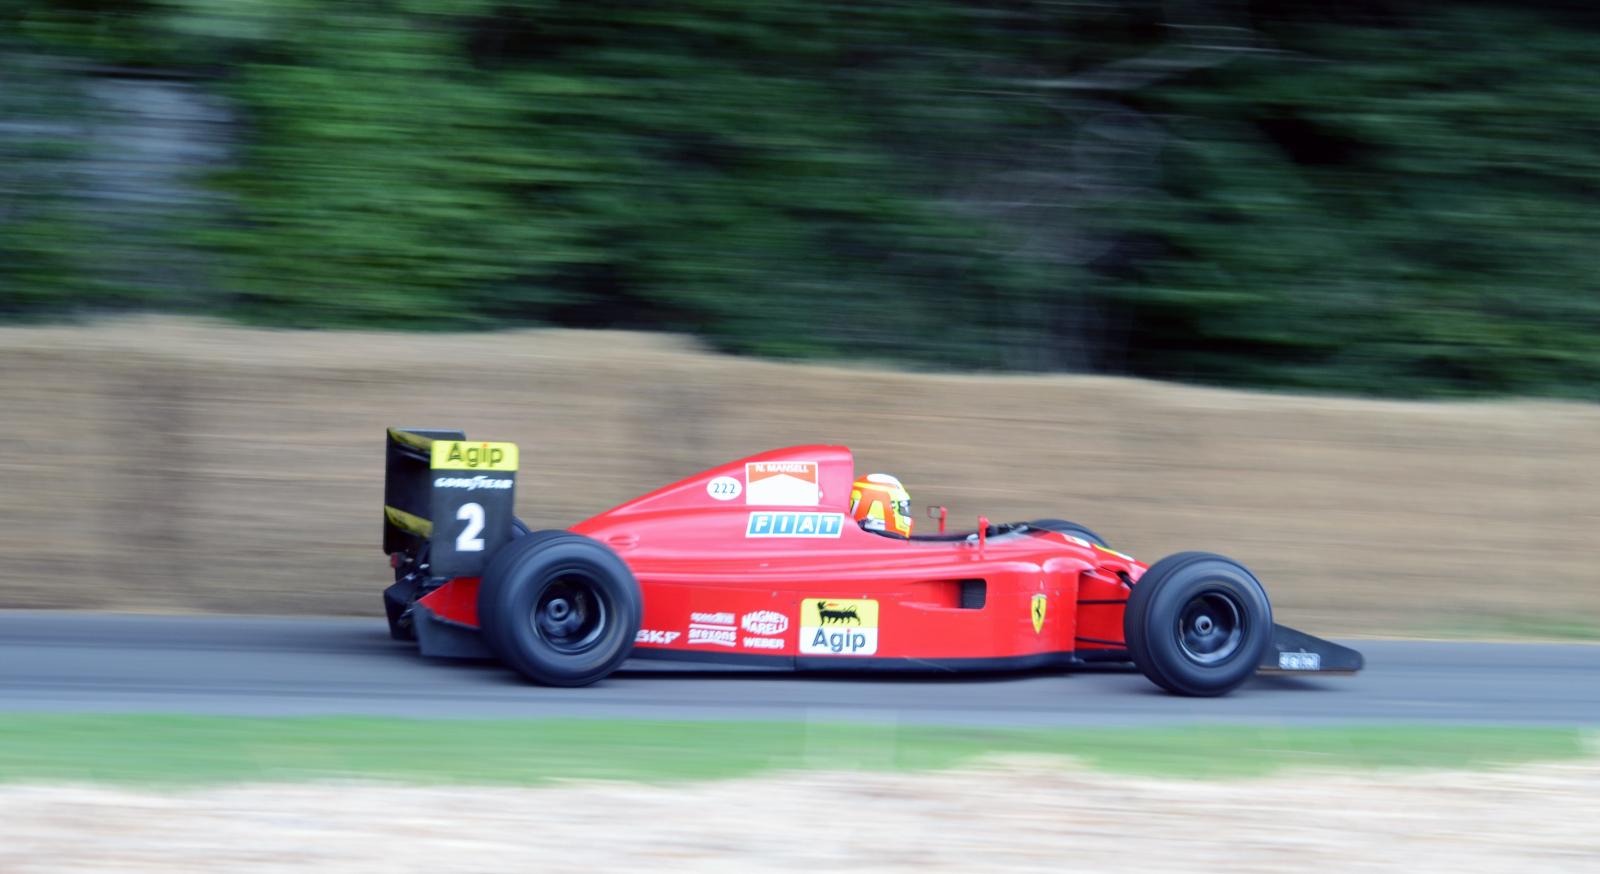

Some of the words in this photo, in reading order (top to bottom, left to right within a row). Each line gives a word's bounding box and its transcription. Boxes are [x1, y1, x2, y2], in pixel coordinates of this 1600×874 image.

[447, 442, 504, 467] Agip
[767, 463, 809, 473] MANSELL
[714, 482, 736, 494] 222
[456, 502, 486, 551] 2
[755, 515, 837, 532] FIAT
[634, 629, 681, 644] SKF
[743, 637, 785, 649] WEBER
[812, 629, 866, 654] Agip
